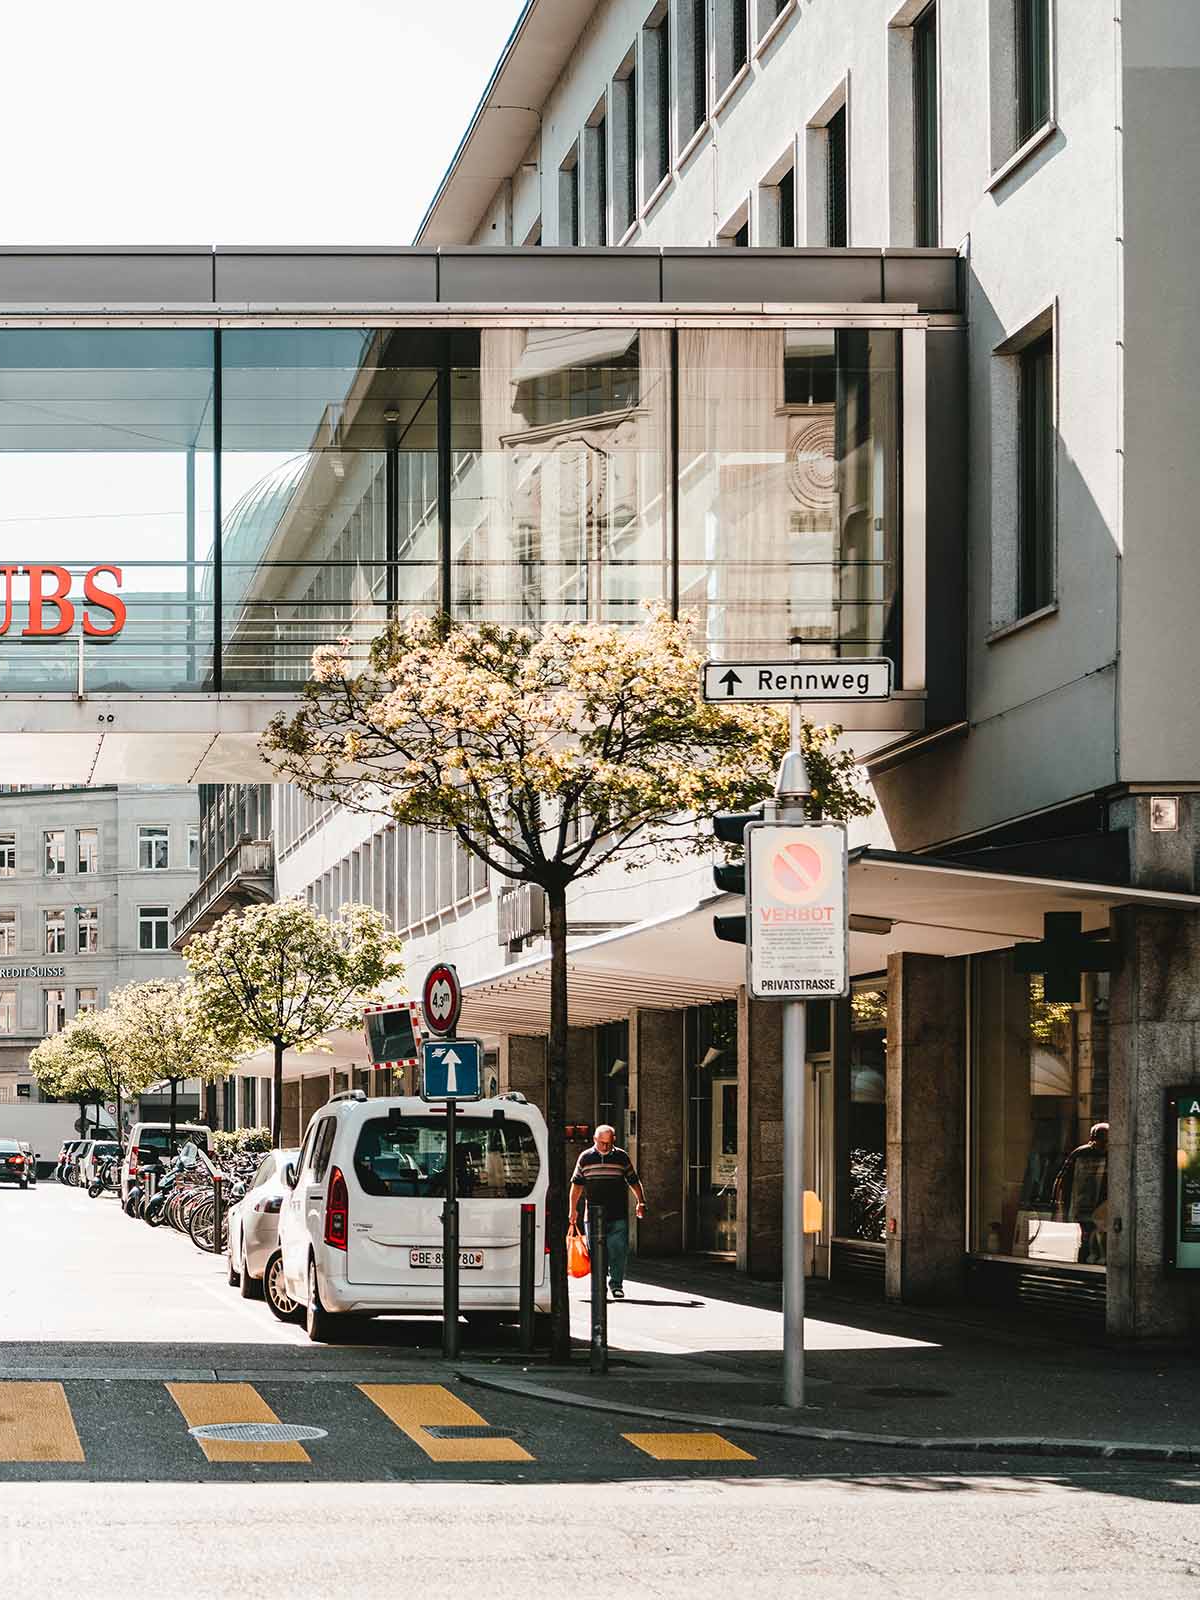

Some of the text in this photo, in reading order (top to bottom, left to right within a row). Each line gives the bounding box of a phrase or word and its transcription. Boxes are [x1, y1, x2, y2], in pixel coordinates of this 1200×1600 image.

[758, 669, 870, 695] Rennweg
[760, 907, 835, 922] VERBOT
[30, 965, 65, 977] SUISSE
[761, 979, 836, 991] PRIVATSTRASSE
